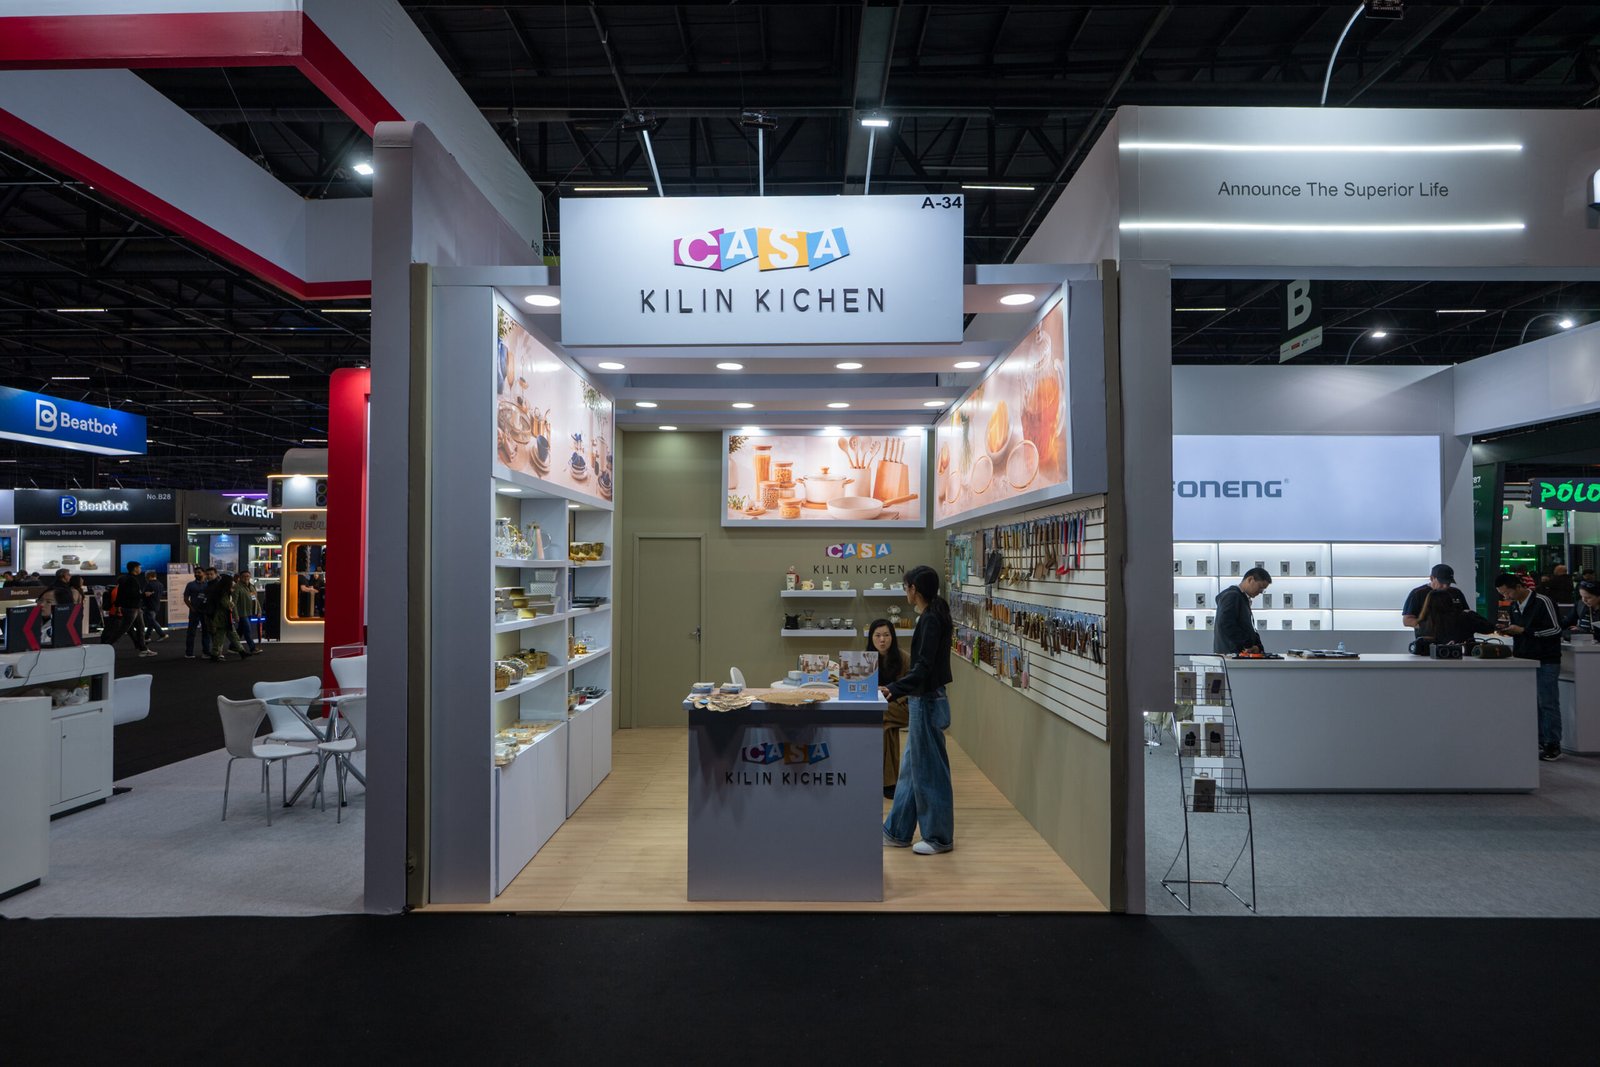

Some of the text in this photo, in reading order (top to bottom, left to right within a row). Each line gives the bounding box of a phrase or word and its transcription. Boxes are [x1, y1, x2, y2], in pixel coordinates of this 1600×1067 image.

[1217, 181, 1449, 200] Announce The Superior Life
[921, 196, 963, 209] A-34
[674, 227, 850, 271] CASA
[640, 287, 885, 313] KILIN KICHEN
[1287, 279, 1312, 331] B
[60, 411, 118, 436] Beatbot
[1173, 480, 1282, 498] ONENG
[1540, 480, 1600, 503] PÓLO
[78, 500, 129, 512] Beatbot
[826, 543, 891, 559] CASA
[813, 565, 905, 575] KILIN KICHEN
[742, 743, 830, 765] CASA
[725, 772, 848, 786] KILIN KICHEN
